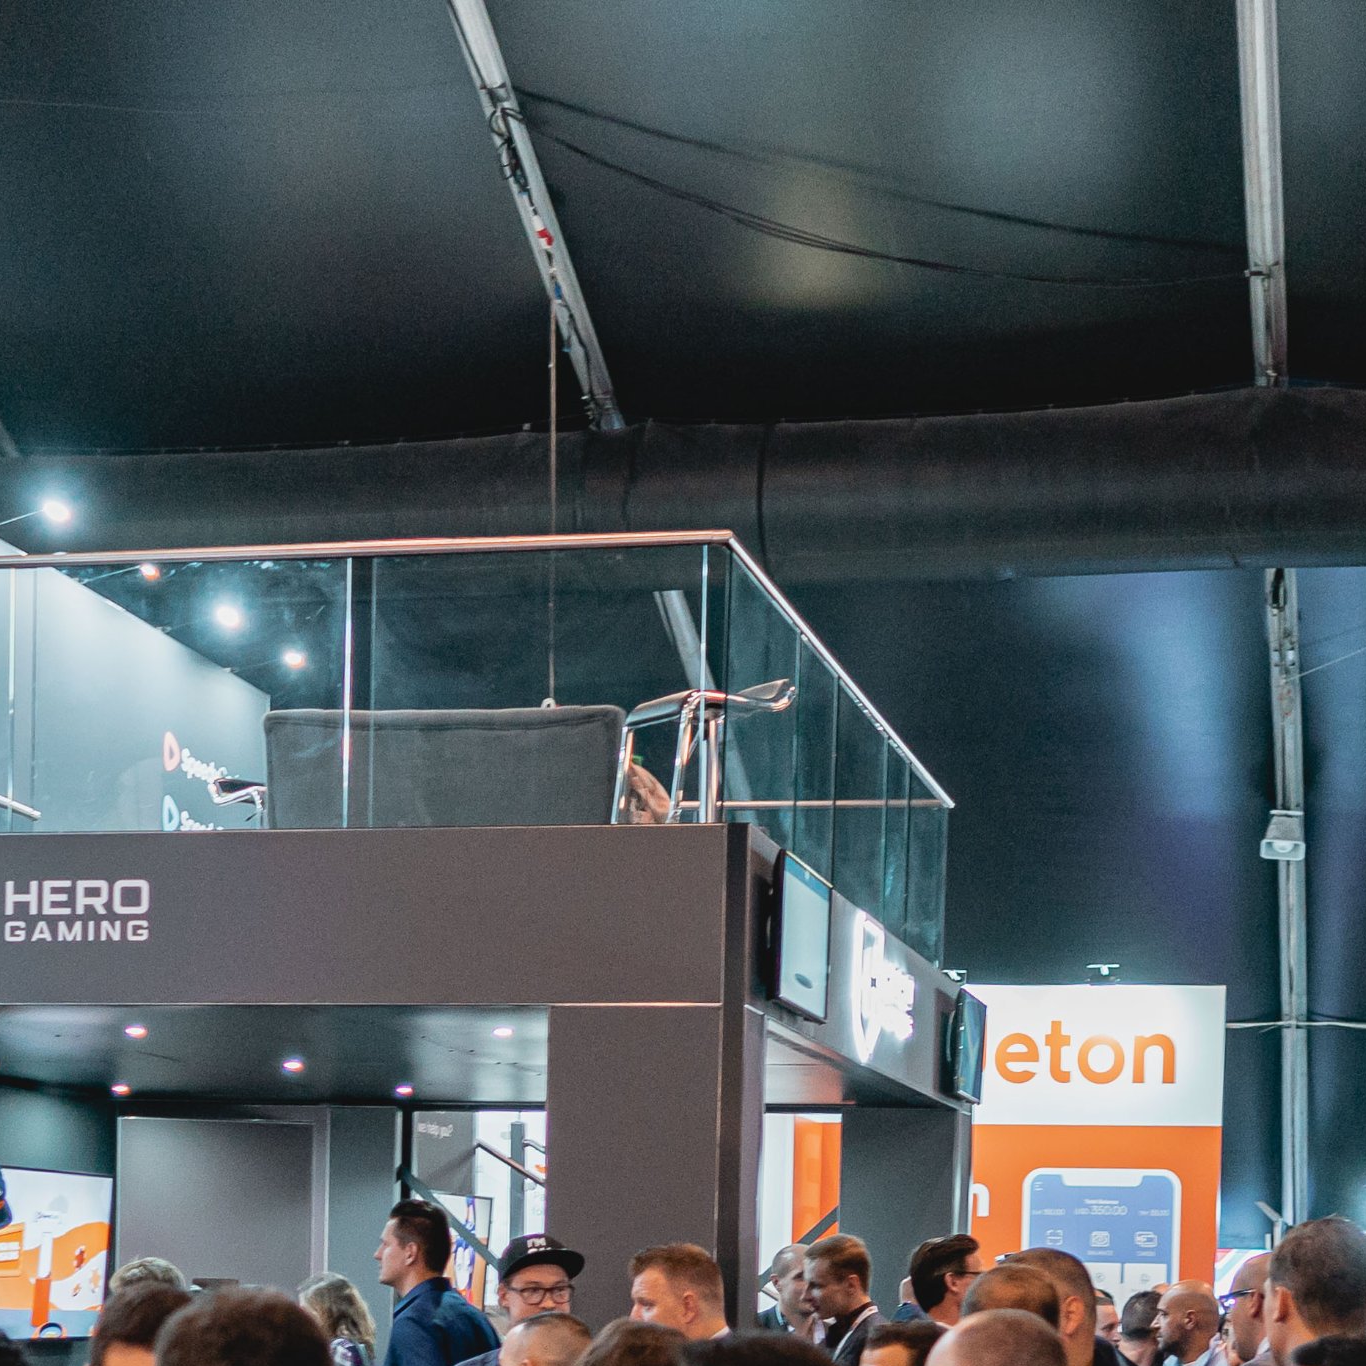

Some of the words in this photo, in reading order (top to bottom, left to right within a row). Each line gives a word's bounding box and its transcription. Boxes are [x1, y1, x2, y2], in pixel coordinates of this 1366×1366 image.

[4, 879, 150, 916] HERO
[4, 920, 150, 942] GAMING
[982, 1020, 1176, 1085] eton
